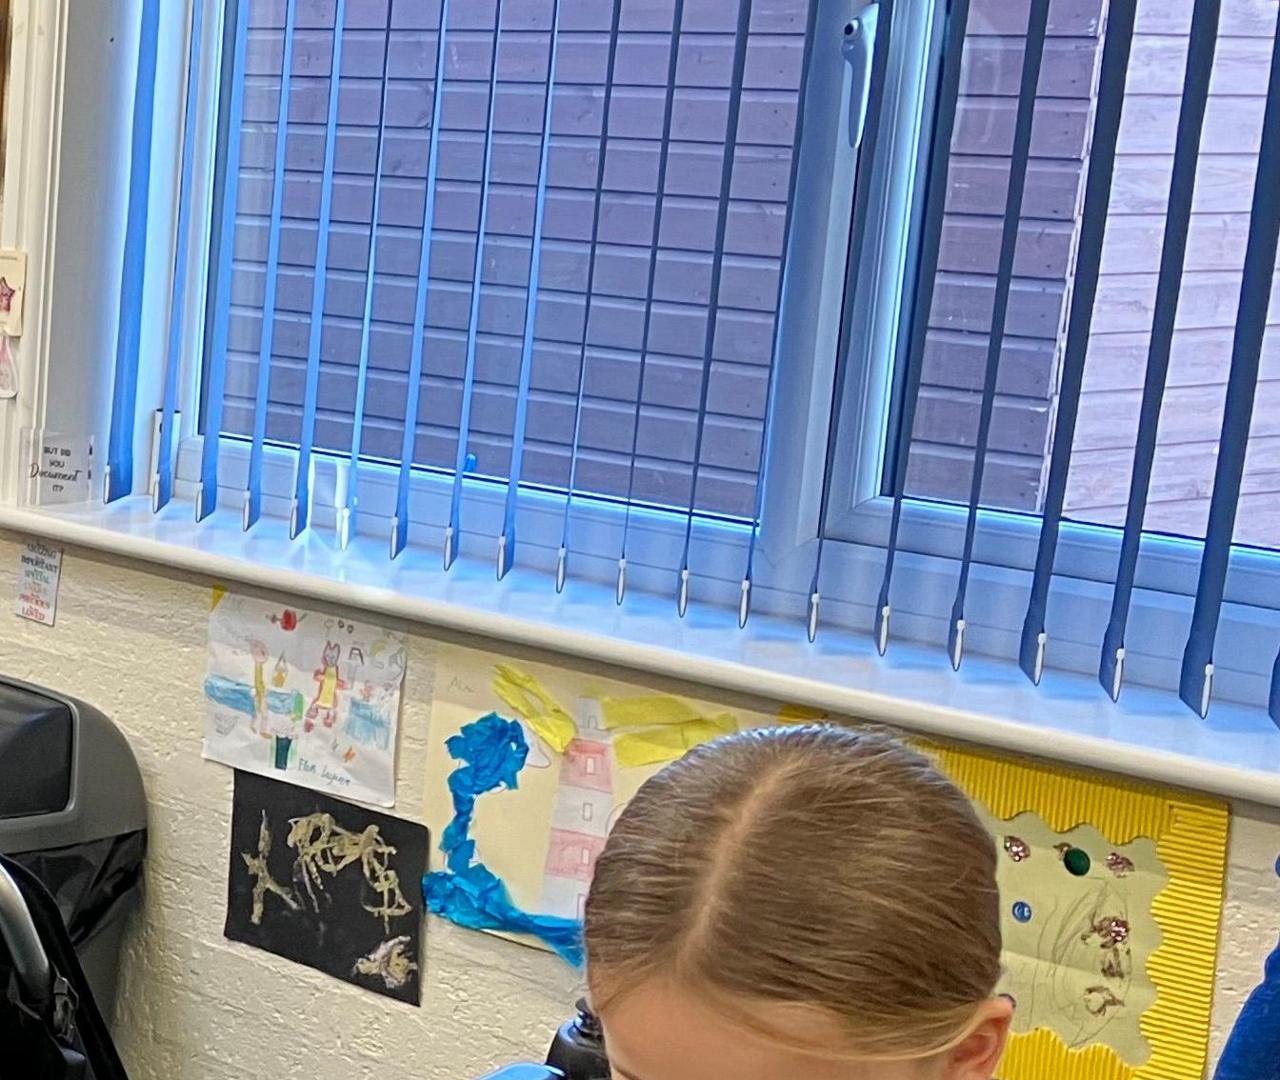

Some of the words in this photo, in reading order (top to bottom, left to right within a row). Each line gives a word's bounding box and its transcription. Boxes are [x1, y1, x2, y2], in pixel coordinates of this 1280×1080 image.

[43, 446, 58, 455] BUT
[49, 459, 65, 468] YOU
[30, 462, 83, 481] Document
